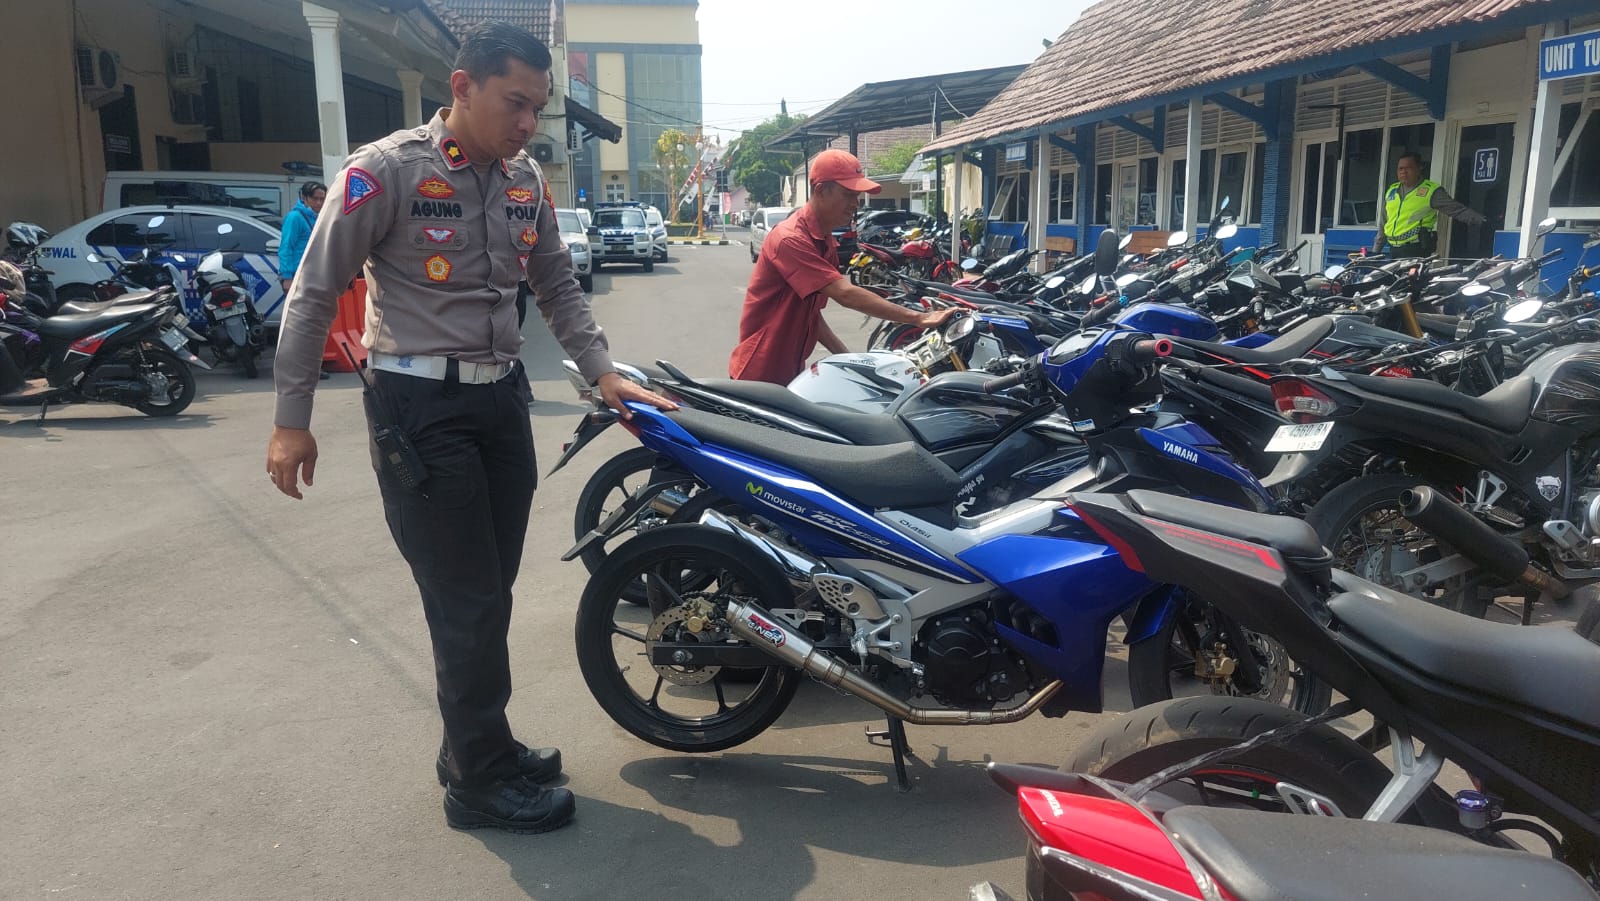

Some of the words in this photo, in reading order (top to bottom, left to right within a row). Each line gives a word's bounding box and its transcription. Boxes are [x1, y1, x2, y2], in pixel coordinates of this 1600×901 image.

[1545, 42, 1575, 72] UNIT
[1479, 152, 1485, 170] 5
[411, 201, 462, 218] AGUNG
[47, 247, 77, 258] WAL
[1163, 441, 1199, 464] YAMAHA
[763, 491, 807, 515] movistar
